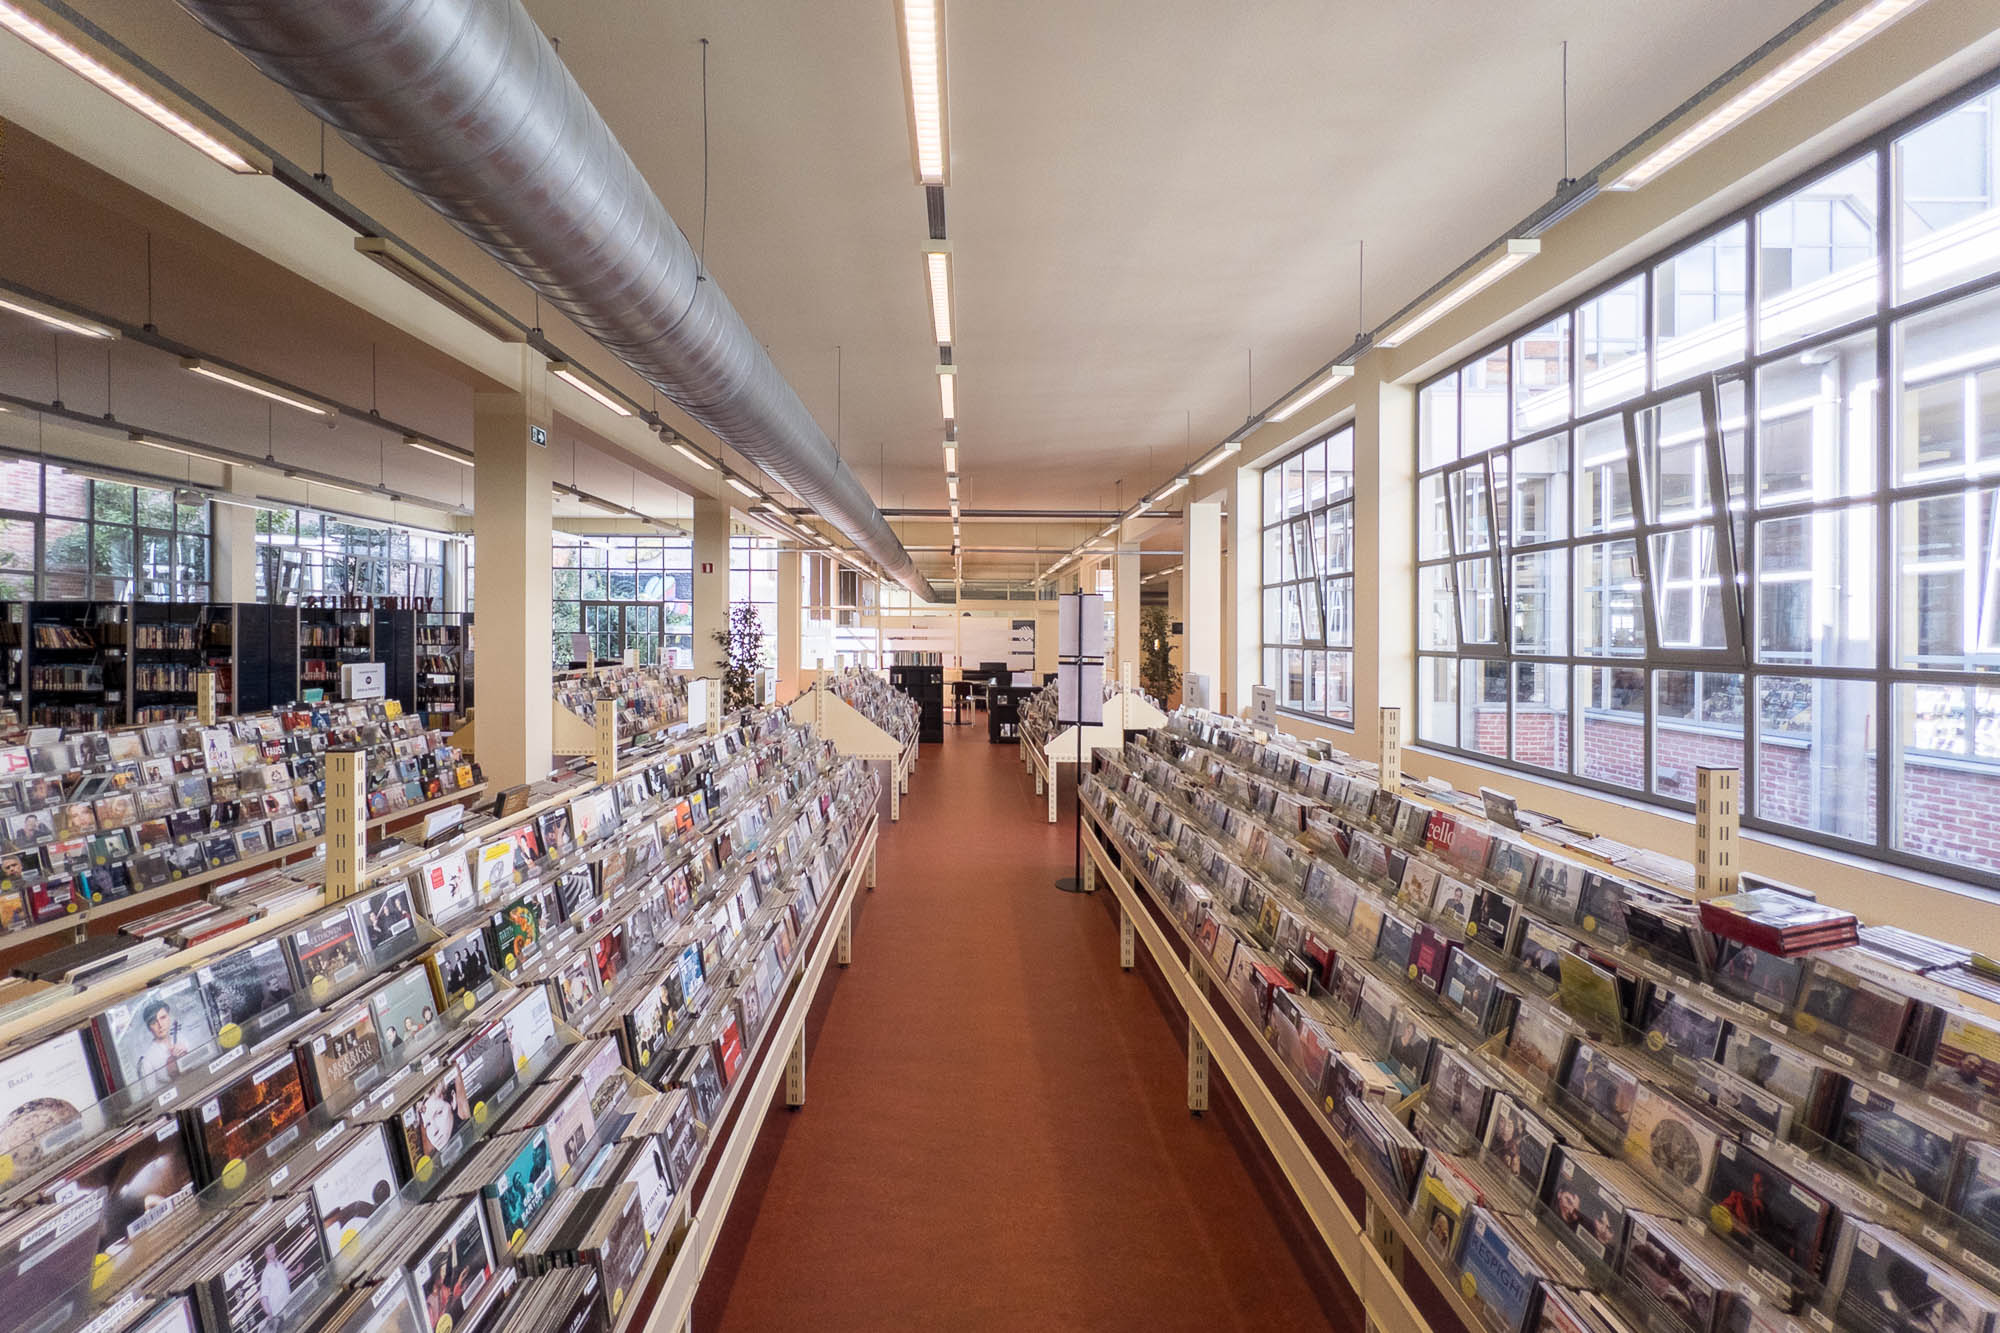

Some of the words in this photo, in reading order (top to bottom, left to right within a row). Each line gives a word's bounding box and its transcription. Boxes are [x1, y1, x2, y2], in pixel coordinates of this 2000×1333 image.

[265, 745, 286, 757] FAUST
[1427, 821, 1455, 846] cello
[309, 924, 342, 945] EETHOVEN
[7, 1071, 33, 1089] BACH
[1471, 1237, 1524, 1299] RESPIGHI
